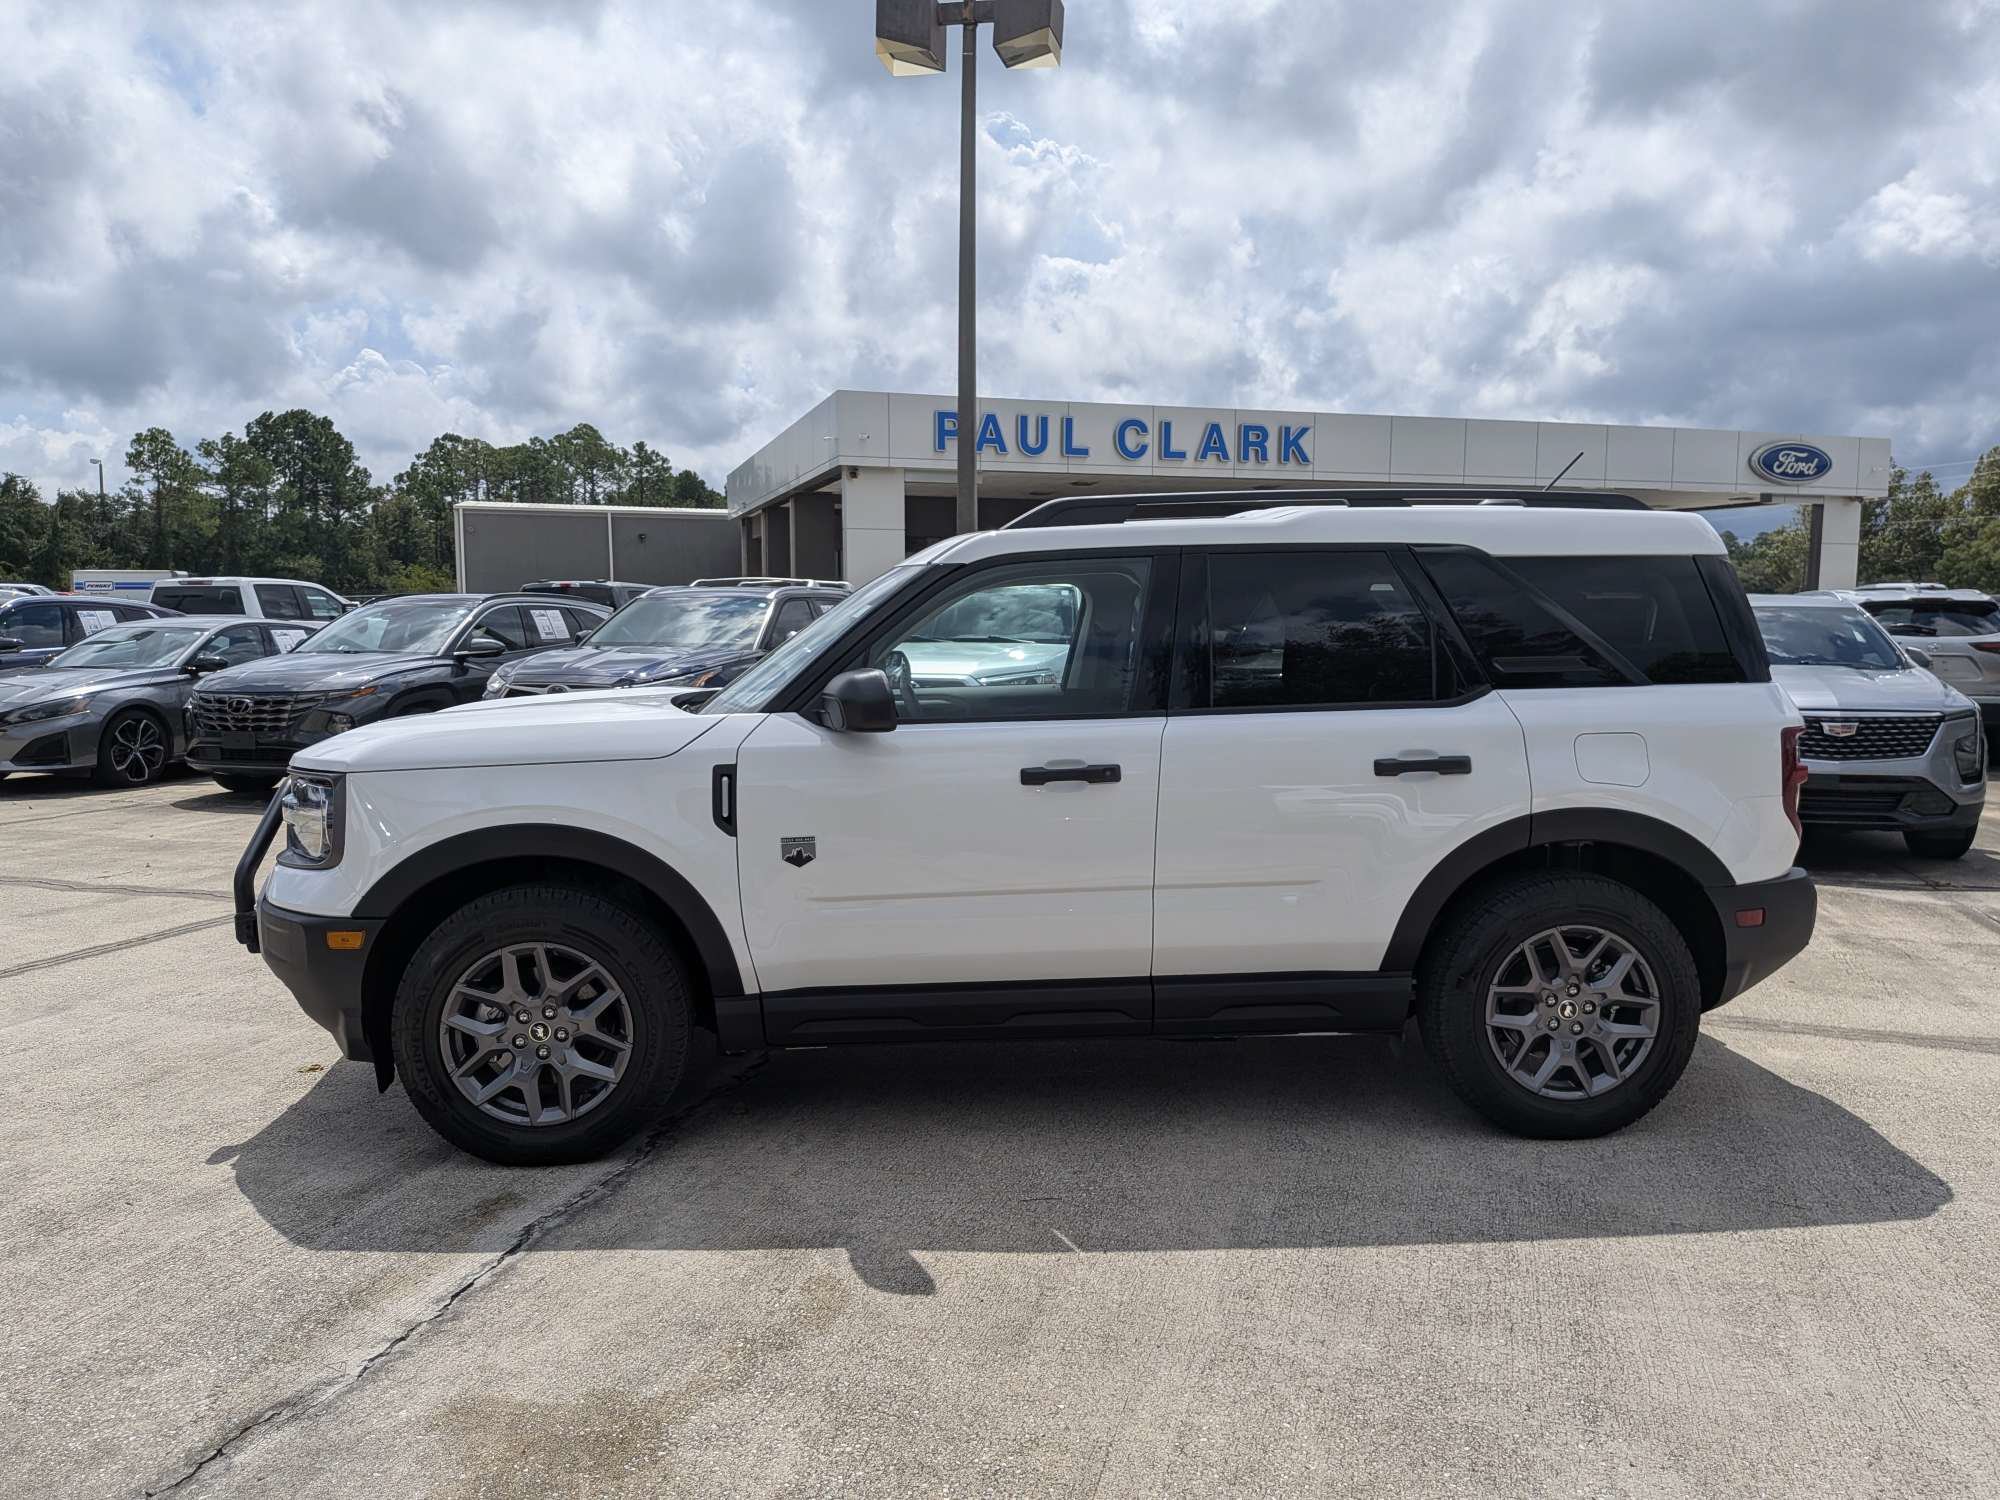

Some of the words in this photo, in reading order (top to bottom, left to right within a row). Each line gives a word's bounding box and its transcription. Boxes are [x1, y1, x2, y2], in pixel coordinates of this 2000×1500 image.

[935, 410, 1089, 456] PAUL
[1116, 418, 1311, 463] CLARK
[1773, 450, 1819, 475] Ford
